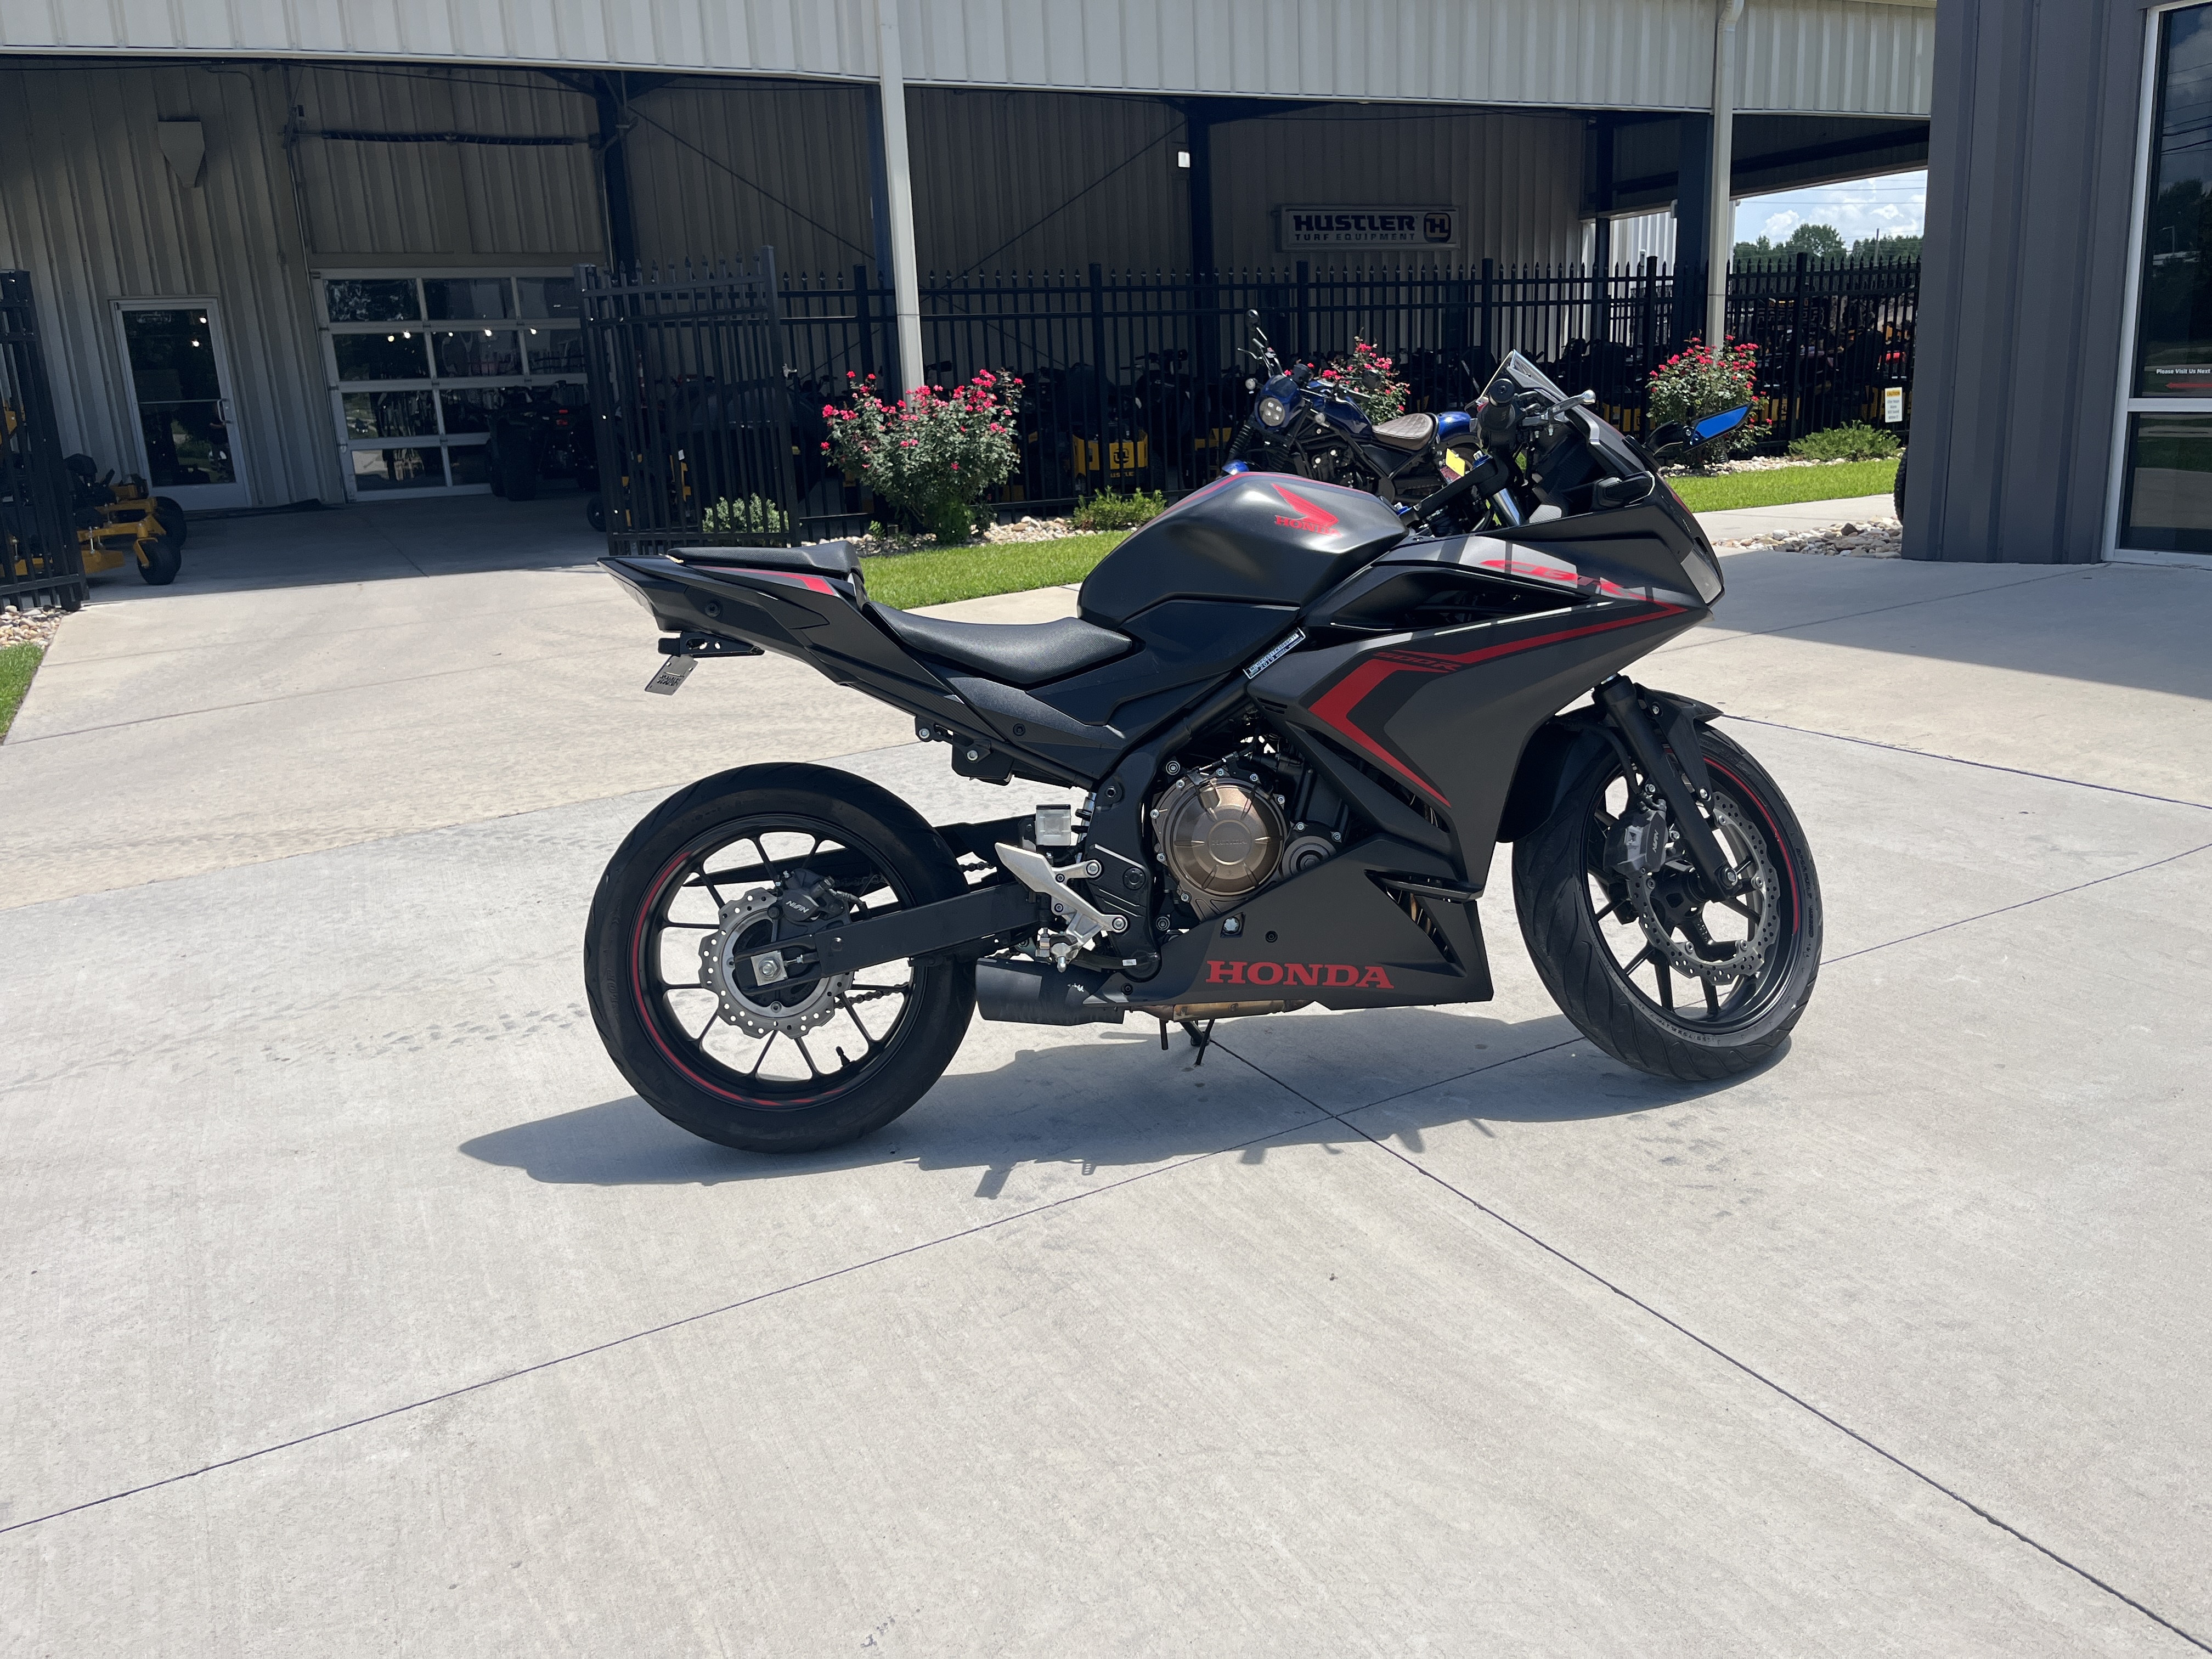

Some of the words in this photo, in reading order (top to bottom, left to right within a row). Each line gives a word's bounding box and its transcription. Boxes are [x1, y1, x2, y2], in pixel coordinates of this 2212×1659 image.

[1293, 215, 1415, 232] HUSTLER
[1335, 233, 1415, 241] EQUIPMENT
[1274, 515, 1343, 538] HONDA
[1205, 960, 1395, 989] HONDA
